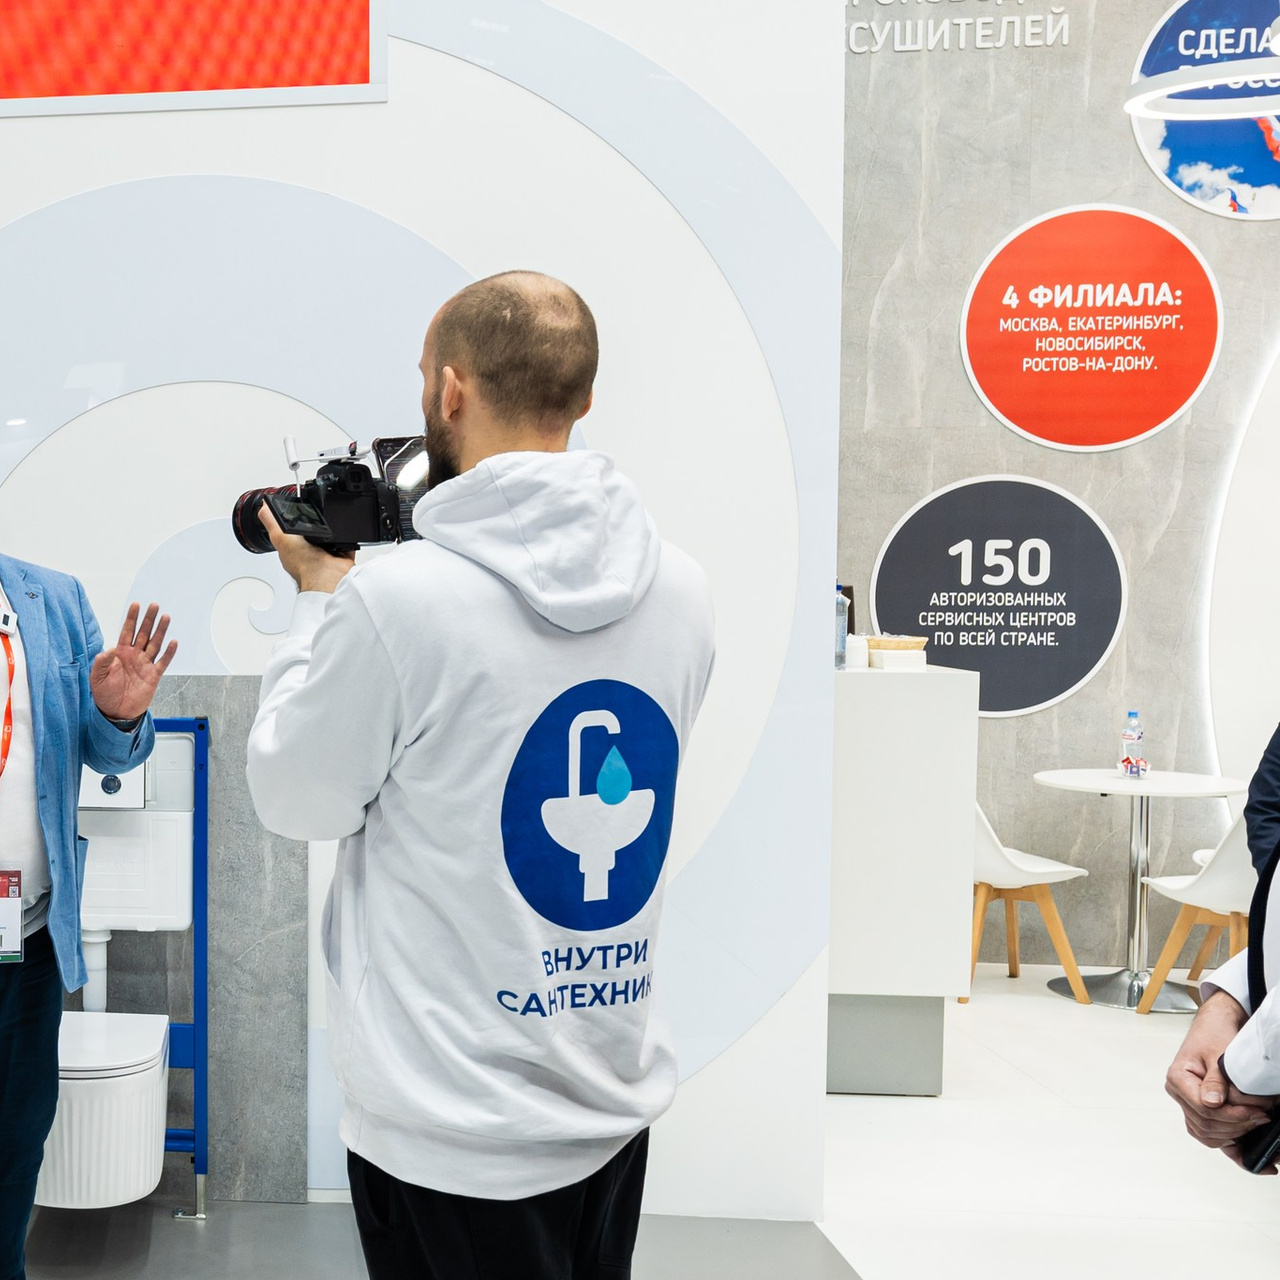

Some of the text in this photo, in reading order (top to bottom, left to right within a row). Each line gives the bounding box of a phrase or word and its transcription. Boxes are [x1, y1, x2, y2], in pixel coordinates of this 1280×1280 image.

[845, 6, 1070, 55] СУШИТЕЛЕЙ
[1001, 282, 1183, 309] 4 ФИЛИАЛА:
[999, 314, 1184, 333] МОСКВА, ЕКАТЕРИНБУРГ,
[1035, 335, 1146, 352] НОВОСИБИРСК,
[1022, 355, 1158, 373] РОСТОВ-НА-ДОНУ.
[948, 537, 1052, 587] 150
[929, 592, 1067, 607] АВТОРИЗОВАННЫХ
[918, 611, 1076, 628] СЕРВИСНЫХ ЦЕНТРОВ
[933, 629, 1059, 646] ПО ВСЕЙ СТРАНЕ.
[541, 938, 649, 977] ВНУТРИ
